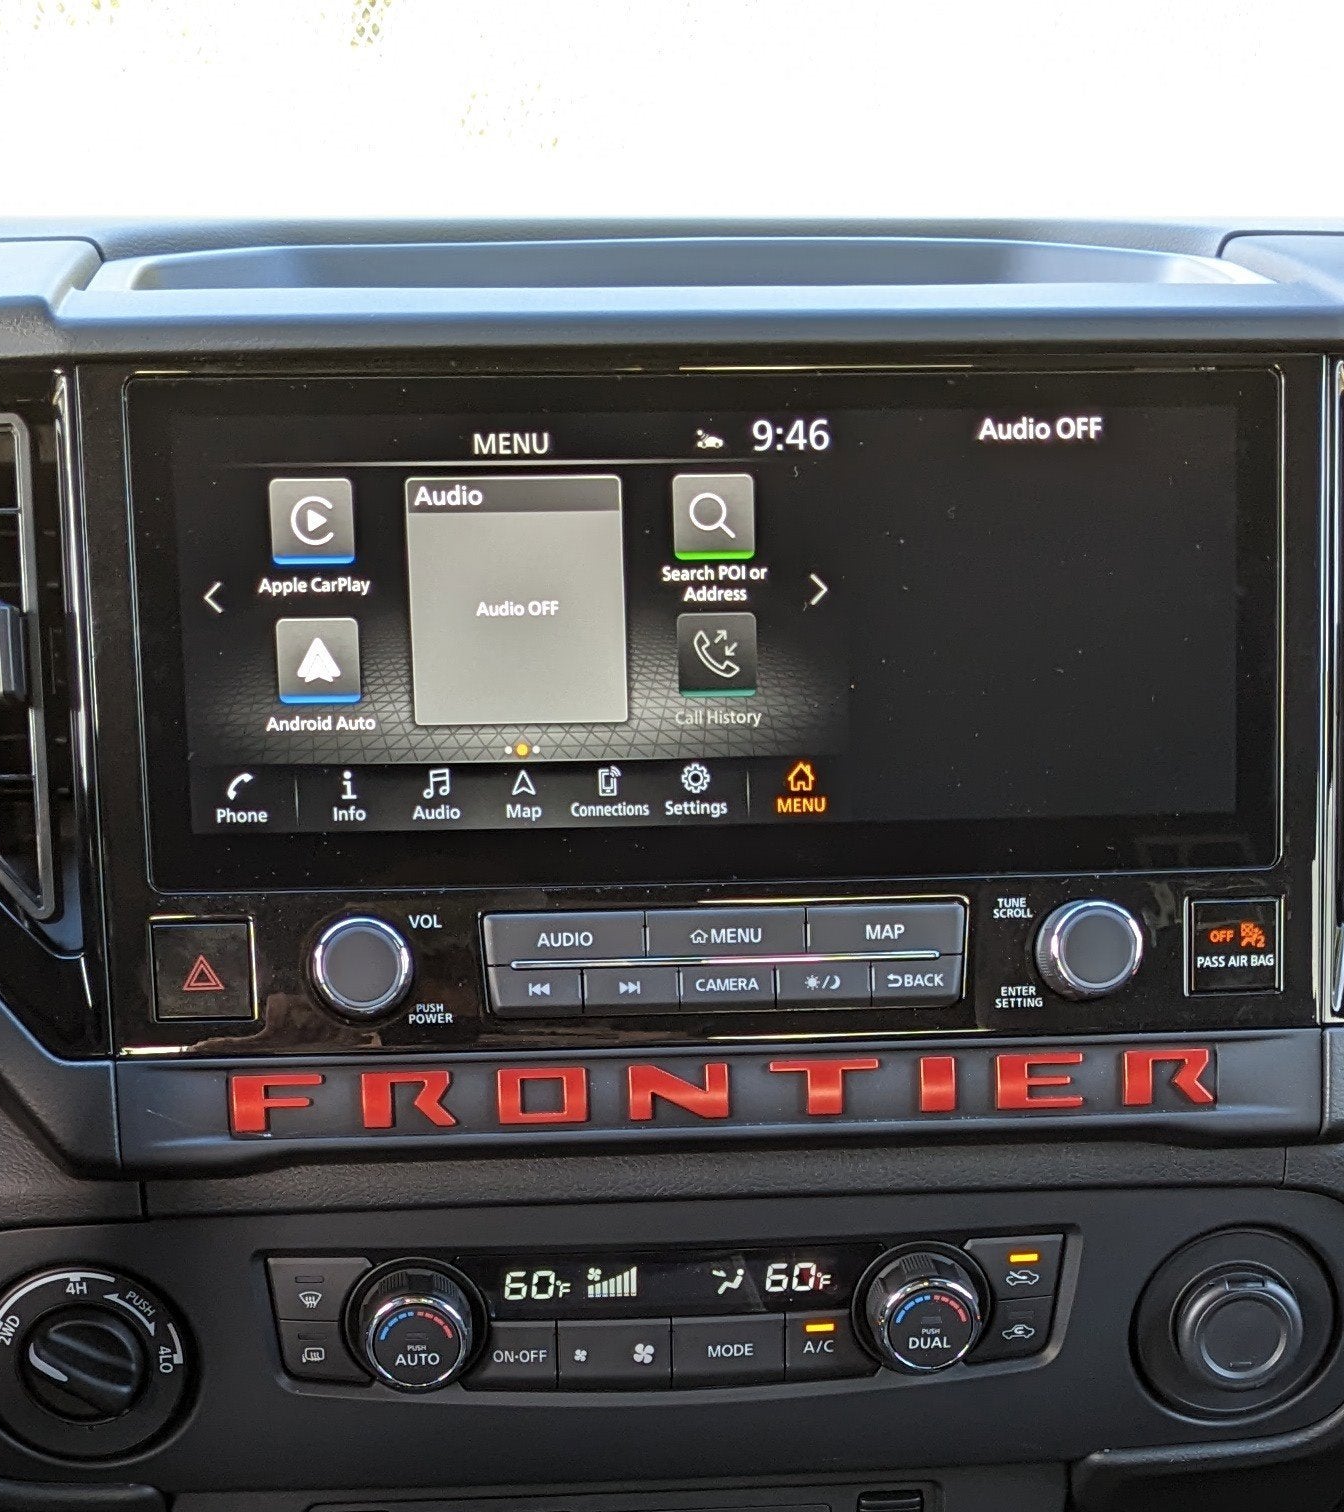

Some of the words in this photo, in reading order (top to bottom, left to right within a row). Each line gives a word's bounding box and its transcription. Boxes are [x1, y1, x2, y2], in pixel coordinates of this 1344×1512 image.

[752, 419, 829, 452] 9:46
[978, 418, 1051, 441] Audio
[1055, 417, 1103, 440] OFF
[473, 432, 550, 455] MENU
[414, 485, 483, 506] Audio
[661, 565, 714, 582] Search
[718, 565, 746, 581] POI
[749, 566, 768, 581] or
[258, 578, 307, 595] Apple
[311, 577, 371, 595] CarPlay
[683, 586, 747, 602] Address
[476, 601, 525, 617] Audio
[528, 600, 559, 616] OFF
[266, 716, 332, 733] Android
[336, 716, 376, 731] Auto
[675, 710, 704, 725] Call
[707, 708, 762, 727] History
[333, 805, 367, 822] Info
[413, 805, 461, 821] Audio
[506, 804, 543, 823] Map
[570, 800, 650, 818] Connections
[665, 798, 728, 818] Settings
[776, 798, 826, 813] MENU
[216, 806, 268, 824] Phone
[997, 898, 1027, 909] TUNE
[992, 907, 1033, 919] SCROLL
[408, 914, 443, 930] VOL
[537, 931, 594, 947] AUDIO
[710, 926, 762, 944] MENU
[865, 923, 905, 940] MAP
[1210, 929, 1234, 942] OFF
[1196, 956, 1225, 968] PASS
[1228, 955, 1248, 967] AIR
[1251, 954, 1274, 966] BAG
[695, 975, 759, 993] CAMERA
[904, 972, 944, 988] BACK
[1000, 986, 1036, 997] ENTER
[416, 1003, 444, 1013] PUSH
[994, 997, 1043, 1009] SETTING
[408, 1013, 454, 1025] POWER
[229, 1048, 1215, 1135] FRONTIER
[65, 1282, 88, 1295] 4H
[125, 1291, 156, 1317] PUSH
[708, 1344, 754, 1358] MODE
[803, 1340, 834, 1353] A/C
[908, 1337, 951, 1349] DUAL
[158, 1345, 174, 1374] 4LO
[395, 1353, 440, 1366] AUTO
